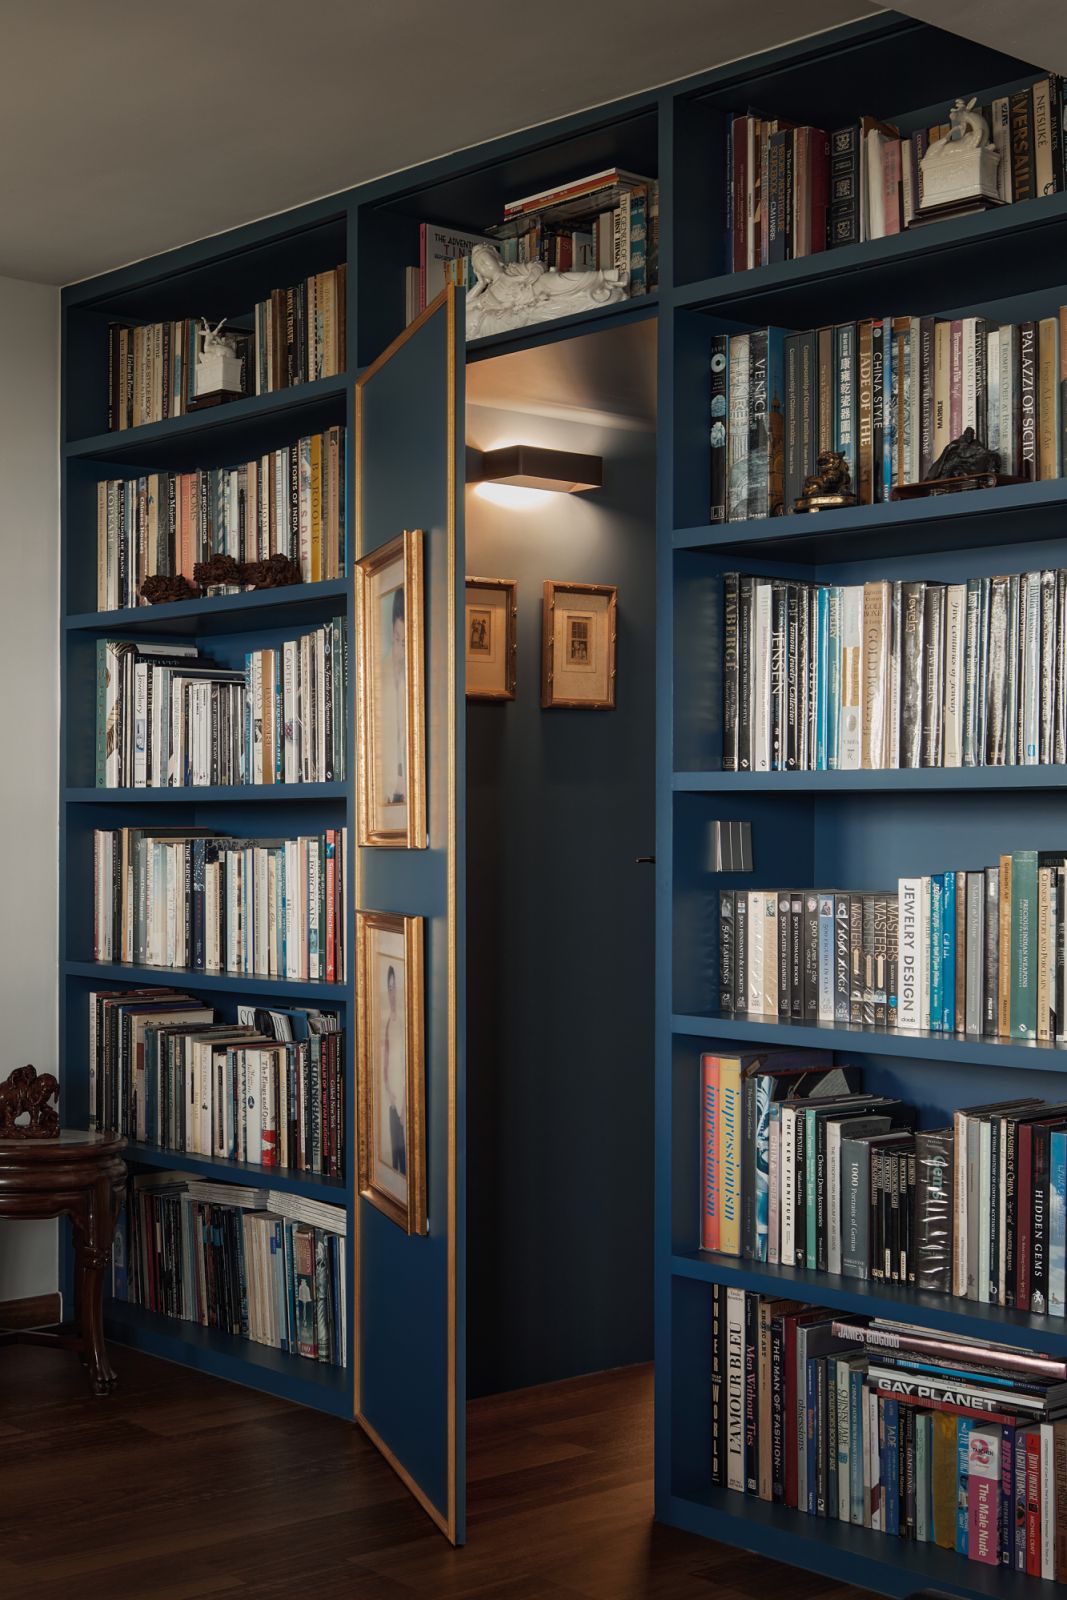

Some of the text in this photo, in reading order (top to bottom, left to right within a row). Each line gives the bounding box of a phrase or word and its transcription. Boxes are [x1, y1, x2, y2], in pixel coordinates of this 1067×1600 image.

[1011, 100, 1032, 200] VERSAILL
[435, 233, 446, 243] THE
[621, 249, 627, 260] OF
[754, 359, 766, 422] VENICE
[860, 352, 871, 446] JADE OF THE
[873, 352, 882, 429] CHINA STYLE
[967, 385, 975, 402] FOR
[1022, 330, 1034, 462] PALAZZI OF SICILY
[292, 493, 298, 503] OF
[312, 462, 320, 544] BAROQUE
[725, 592, 739, 672] FABERGÉ
[907, 592, 918, 634] Jewelry
[789, 622, 797, 653] Famous
[866, 628, 879, 671] GOLD
[771, 632, 784, 694] JENSEN
[788, 655, 797, 684] Jewelry
[136, 672, 144, 714] Jewellery
[851, 903, 861, 953] MASTERS
[874, 902, 885, 961] MASTERS
[887, 903, 898, 962] MASTERS
[903, 885, 915, 1012] JEWELRY DESIGN
[722, 944, 730, 985] EARRINGS
[810, 939, 818, 961] figures
[810, 971, 818, 984] clay
[322, 1080, 327, 1088] OF
[703, 1085, 720, 1217] impressionism
[721, 1088, 740, 1221] impressionism
[1007, 1159, 1014, 1171] OF
[851, 1161, 859, 1186] 1000
[932, 1155, 946, 1200] Gems
[1006, 1171, 1015, 1197] CHINA
[850, 1218, 857, 1226] of
[1034, 1190, 1044, 1277] HIDDEN GEMS
[838, 1325, 900, 1349] JAMES BIDGOOD
[727, 1322, 742, 1455] L'AMOUR BLEU
[746, 1344, 757, 1446] Men Without Ties
[773, 1395, 781, 1409] OF
[878, 1378, 996, 1412] GAY PLANET
[887, 1425, 896, 1448] JADE
[978, 1483, 989, 1556] The Male Nude
